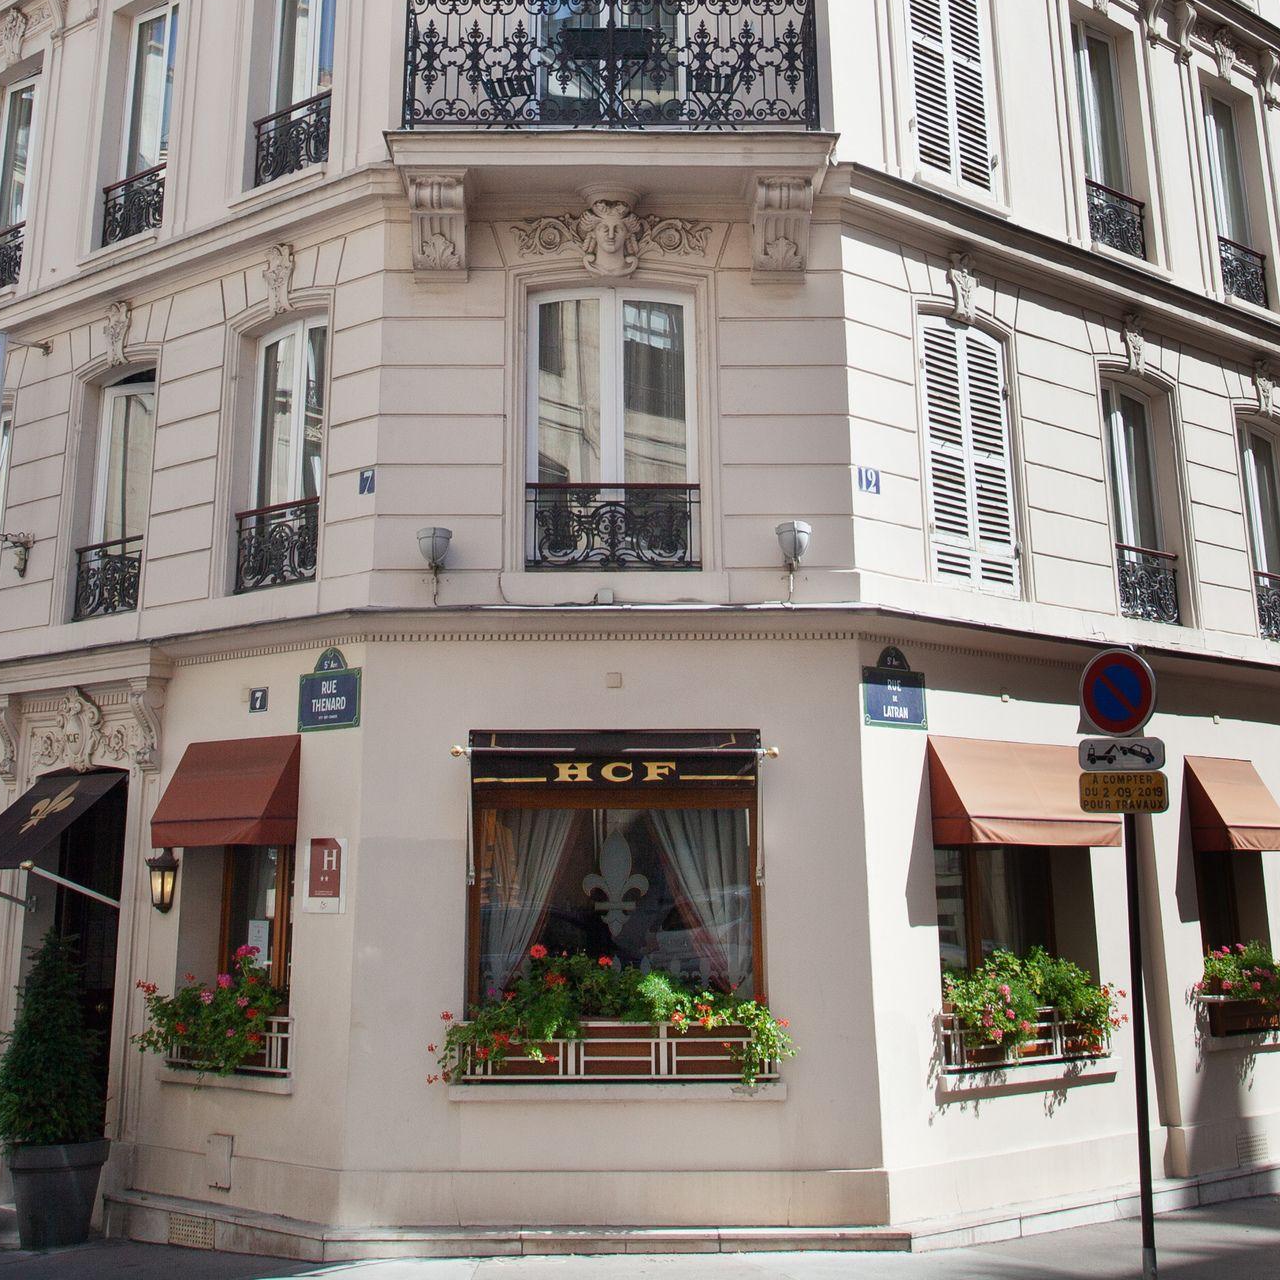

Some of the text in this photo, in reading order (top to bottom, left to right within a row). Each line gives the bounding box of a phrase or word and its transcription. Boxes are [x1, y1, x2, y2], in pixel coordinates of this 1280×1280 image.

[363, 470, 373, 494] 7
[861, 468, 877, 493] 12
[321, 680, 337, 694] RUE
[887, 679, 902, 691] RUE
[255, 691, 263, 709] 7
[312, 696, 346, 712] THENARD
[883, 705, 909, 719] LATRAN
[552, 761, 676, 782] HCF
[1103, 775, 1153, 784] COMPTER
[1085, 788, 1098, 796] DU
[1084, 800, 1164, 810] POUR TRAVAUX
[322, 849, 337, 870] H
